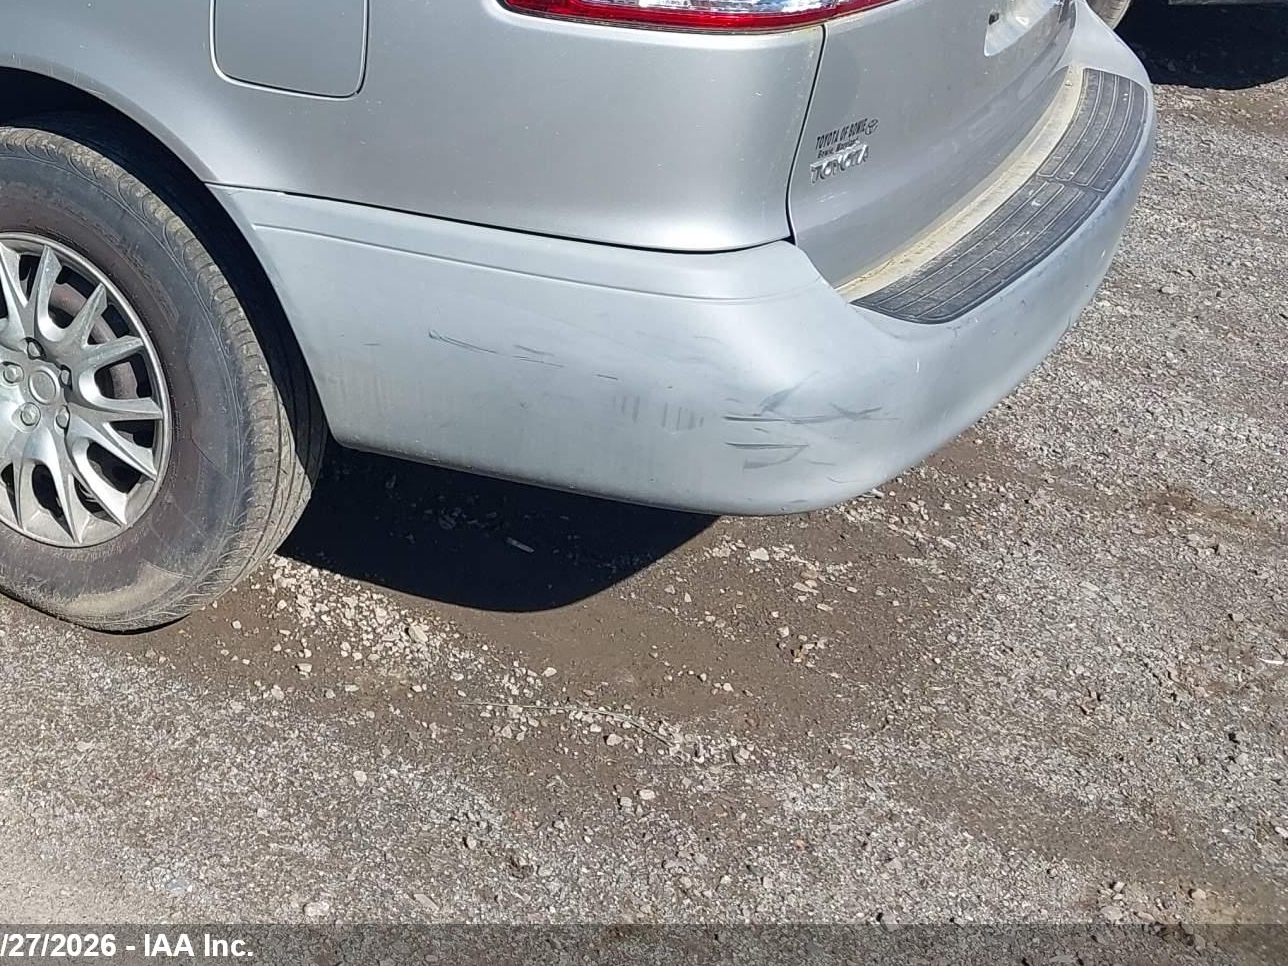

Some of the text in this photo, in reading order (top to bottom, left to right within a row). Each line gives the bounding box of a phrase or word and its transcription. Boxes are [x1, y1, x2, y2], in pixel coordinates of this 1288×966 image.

[815, 129, 840, 150] TOYOTA
[839, 125, 850, 142] OF
[810, 144, 869, 186] TOYOTA
